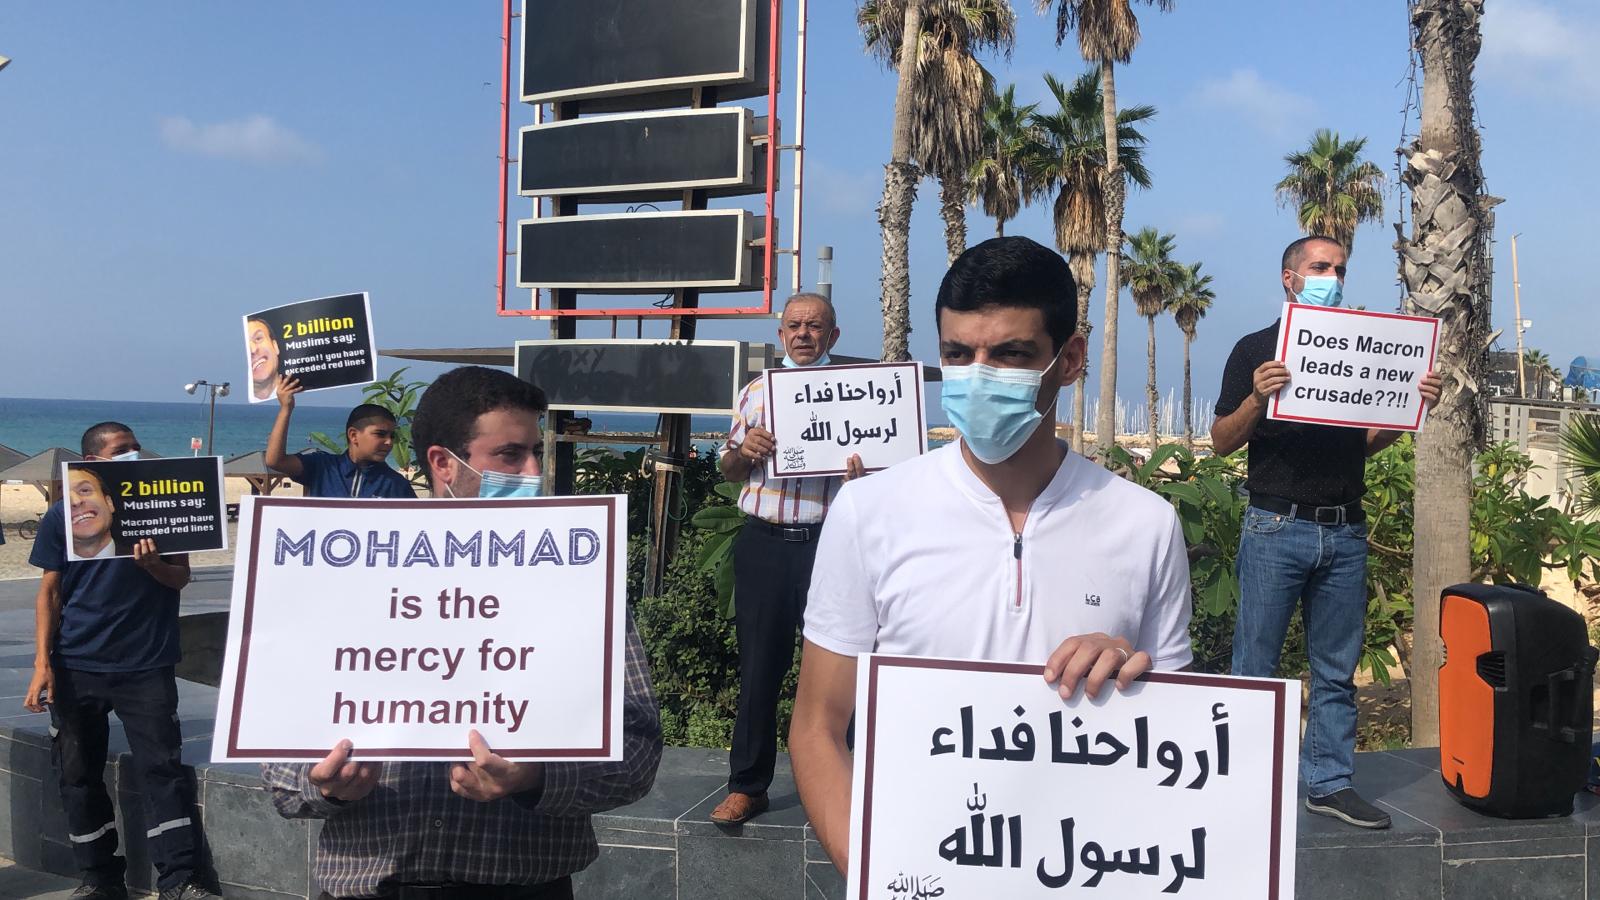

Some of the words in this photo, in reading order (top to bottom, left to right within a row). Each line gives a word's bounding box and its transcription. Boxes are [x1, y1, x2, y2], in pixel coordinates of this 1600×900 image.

[283, 324, 293, 339] 2
[297, 317, 354, 336] billion
[286, 337, 330, 350] Muslims
[333, 333, 356, 344] say:
[284, 352, 323, 366] Macron!!
[325, 352, 341, 361] you
[343, 349, 365, 358] have
[1298, 329, 1349, 350] Does
[1356, 336, 1424, 358] Macron
[285, 363, 326, 375] exceeded
[328, 360, 343, 369] red
[344, 358, 365, 367] lines
[1300, 356, 1353, 377] leads
[1360, 366, 1370, 379] a
[1376, 367, 1414, 383] new
[794, 382, 834, 404] فداء
[837, 372, 902, 405] أرواحنا
[1294, 386, 1409, 408] crusade??!!
[800, 411, 832, 442] الله
[836, 417, 897, 447] لرسول
[121, 482, 133, 497] 2
[139, 479, 204, 496] billion
[124, 499, 177, 510] Muslims
[180, 498, 206, 509] say:
[121, 517, 167, 527] Macron!!
[170, 517, 188, 526] you
[190, 515, 214, 523] have
[122, 527, 170, 537] exceeded
[172, 526, 189, 534] red
[191, 524, 214, 532] lines
[274, 527, 601, 568] MOHAMMAD
[389, 588, 422, 619] is
[438, 588, 500, 619] the
[334, 646, 465, 681] mercy
[479, 639, 534, 671] for
[332, 691, 529, 733] humanity
[930, 705, 1036, 762] فداء
[1049, 702, 1229, 790] أرواحنا
[938, 782, 1022, 869] الله
[1036, 816, 1207, 894] لرسول
